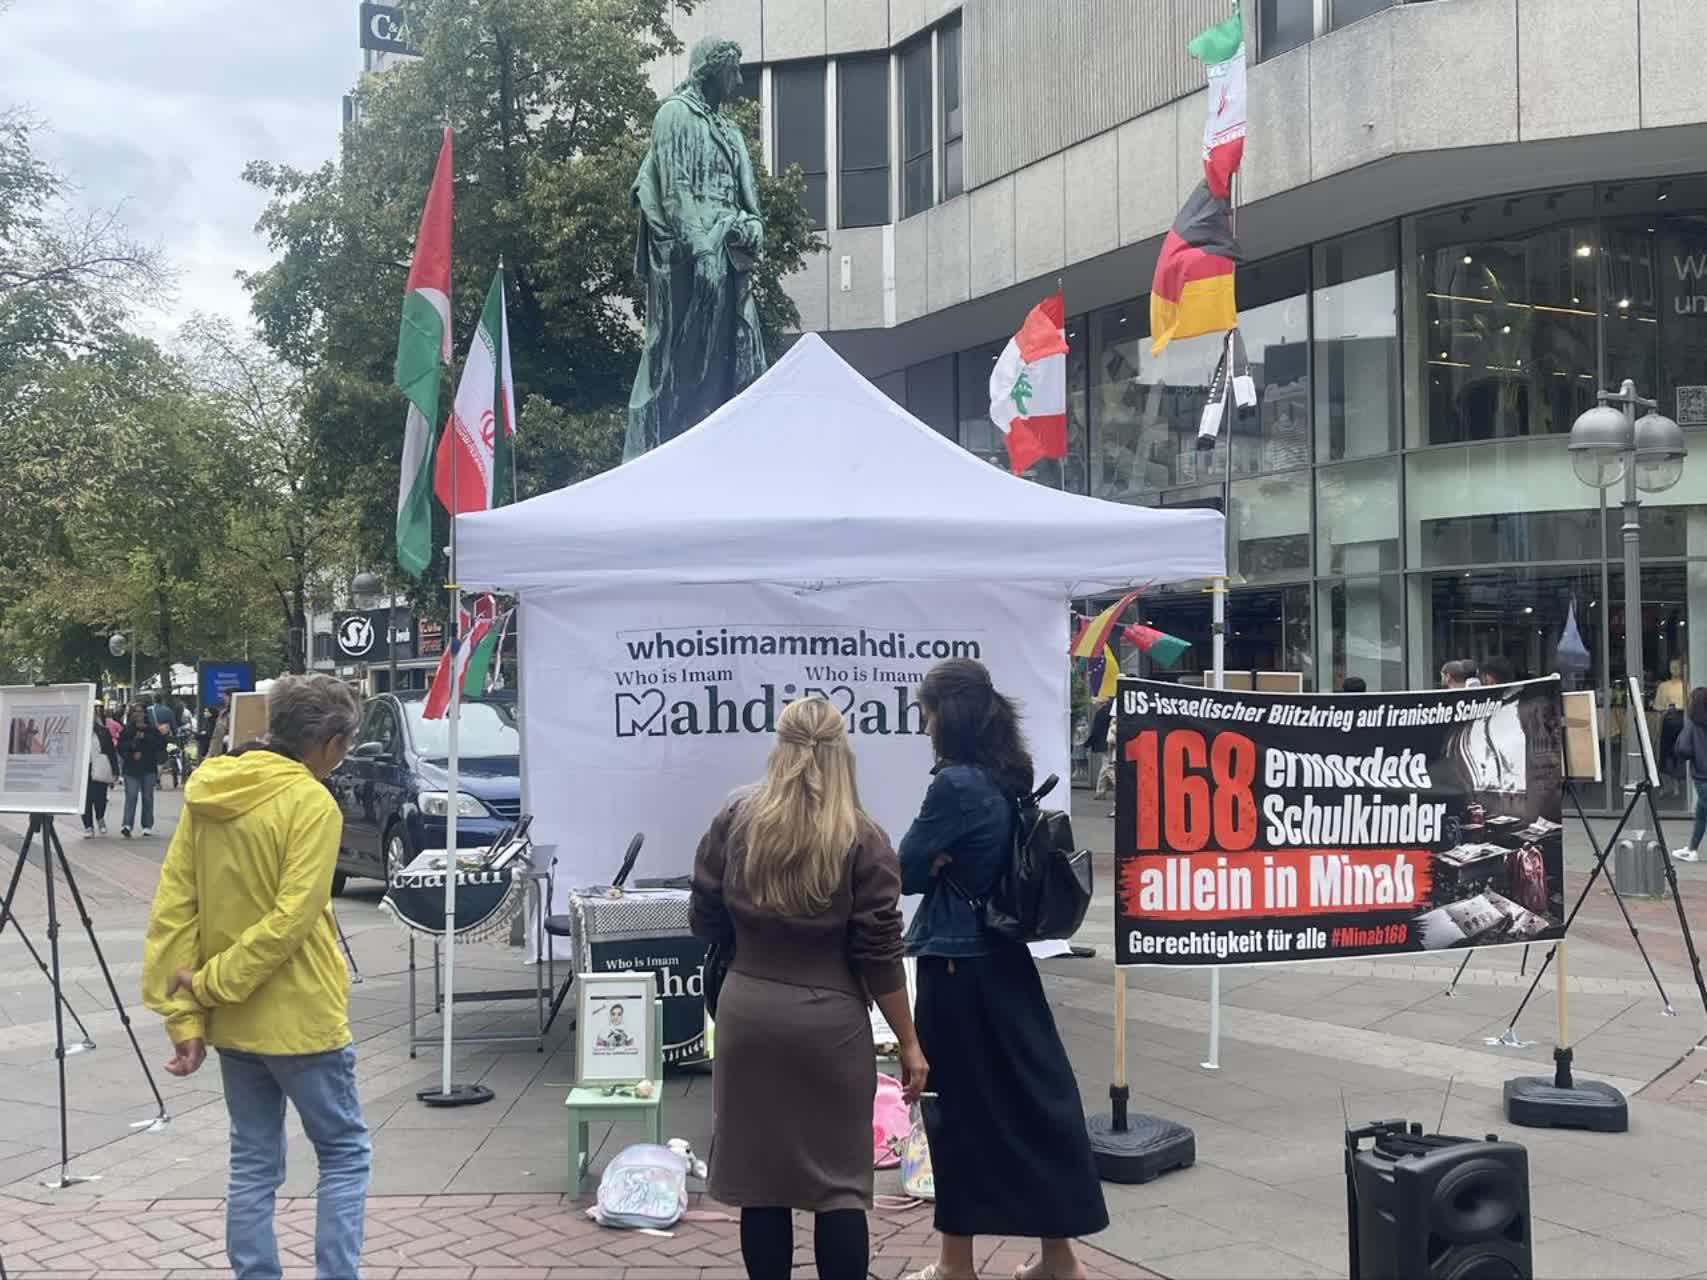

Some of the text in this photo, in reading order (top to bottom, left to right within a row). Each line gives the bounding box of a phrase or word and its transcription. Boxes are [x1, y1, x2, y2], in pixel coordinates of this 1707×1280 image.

[627, 629, 981, 660] whoisimammahdi.com
[615, 668, 733, 686] Who is Imam
[805, 666, 924, 683] Who is Imam
[1124, 690, 1265, 723] US-israelischer
[1268, 704, 1354, 732] Blitzkrieg
[1357, 705, 1385, 728] auf
[1387, 701, 1453, 727] iranische
[1264, 746, 1432, 789] ermordete
[1125, 728, 1258, 851] 168
[1263, 793, 1446, 846] Schulkinder
[1139, 854, 1415, 911] allein in Minab
[1129, 924, 1408, 958] Gerechtigkeit für alle #Minab168
[606, 957, 680, 969] Who is Imam
